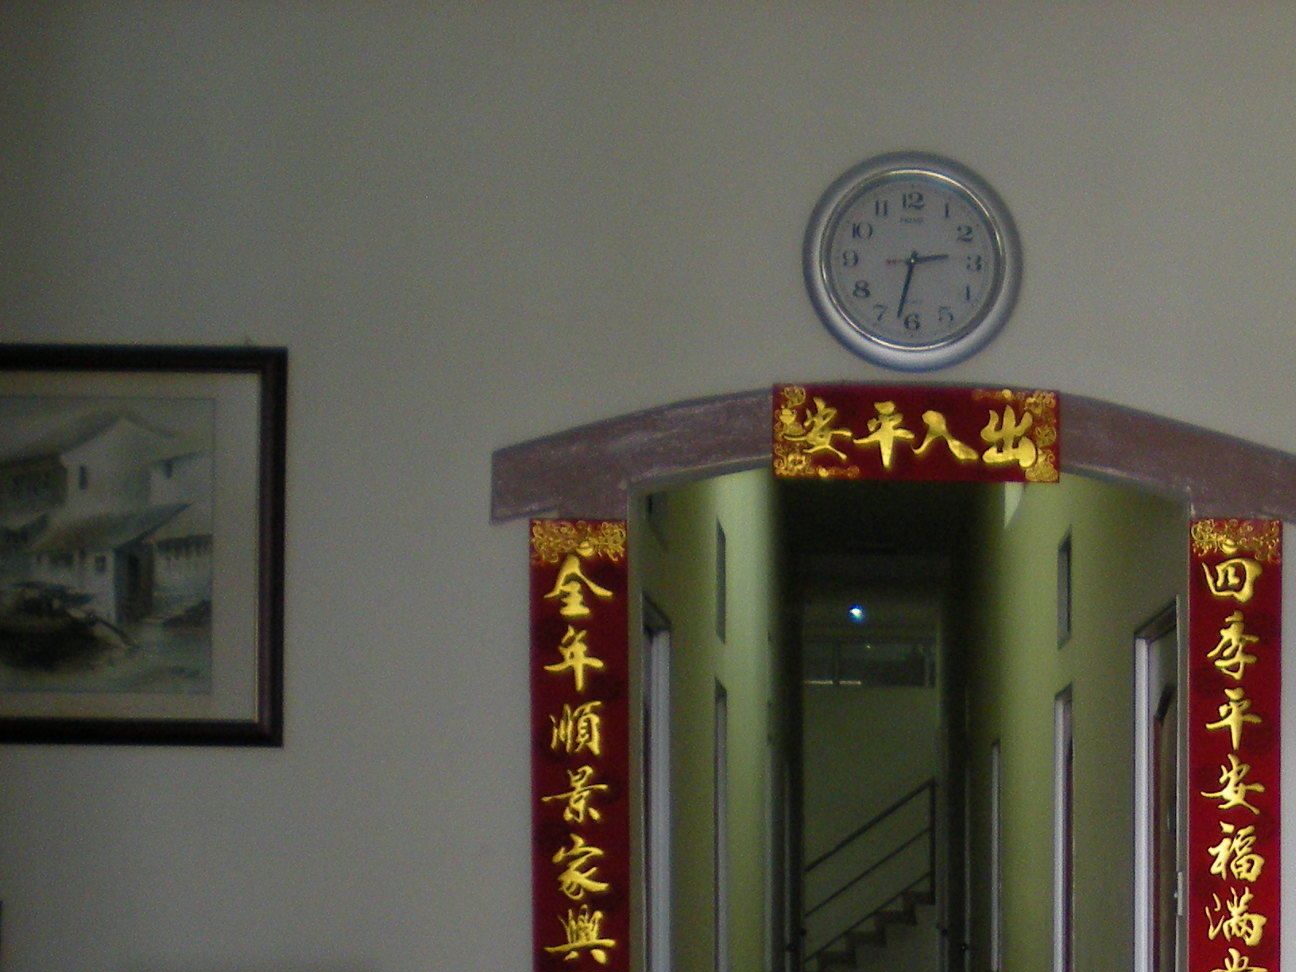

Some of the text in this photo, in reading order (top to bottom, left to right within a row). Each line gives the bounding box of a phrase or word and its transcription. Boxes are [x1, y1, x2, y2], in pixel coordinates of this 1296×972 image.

[874, 200, 889, 215] 11
[902, 192, 925, 210] 12
[944, 203, 950, 218] 1
[852, 222, 873, 240] 10
[957, 225, 973, 242] 2
[842, 250, 859, 267] 9
[967, 256, 982, 272] 3
[853, 280, 870, 298] 8
[873, 304, 888, 321] 7
[938, 306, 954, 323] 5
[904, 314, 920, 331] 6
